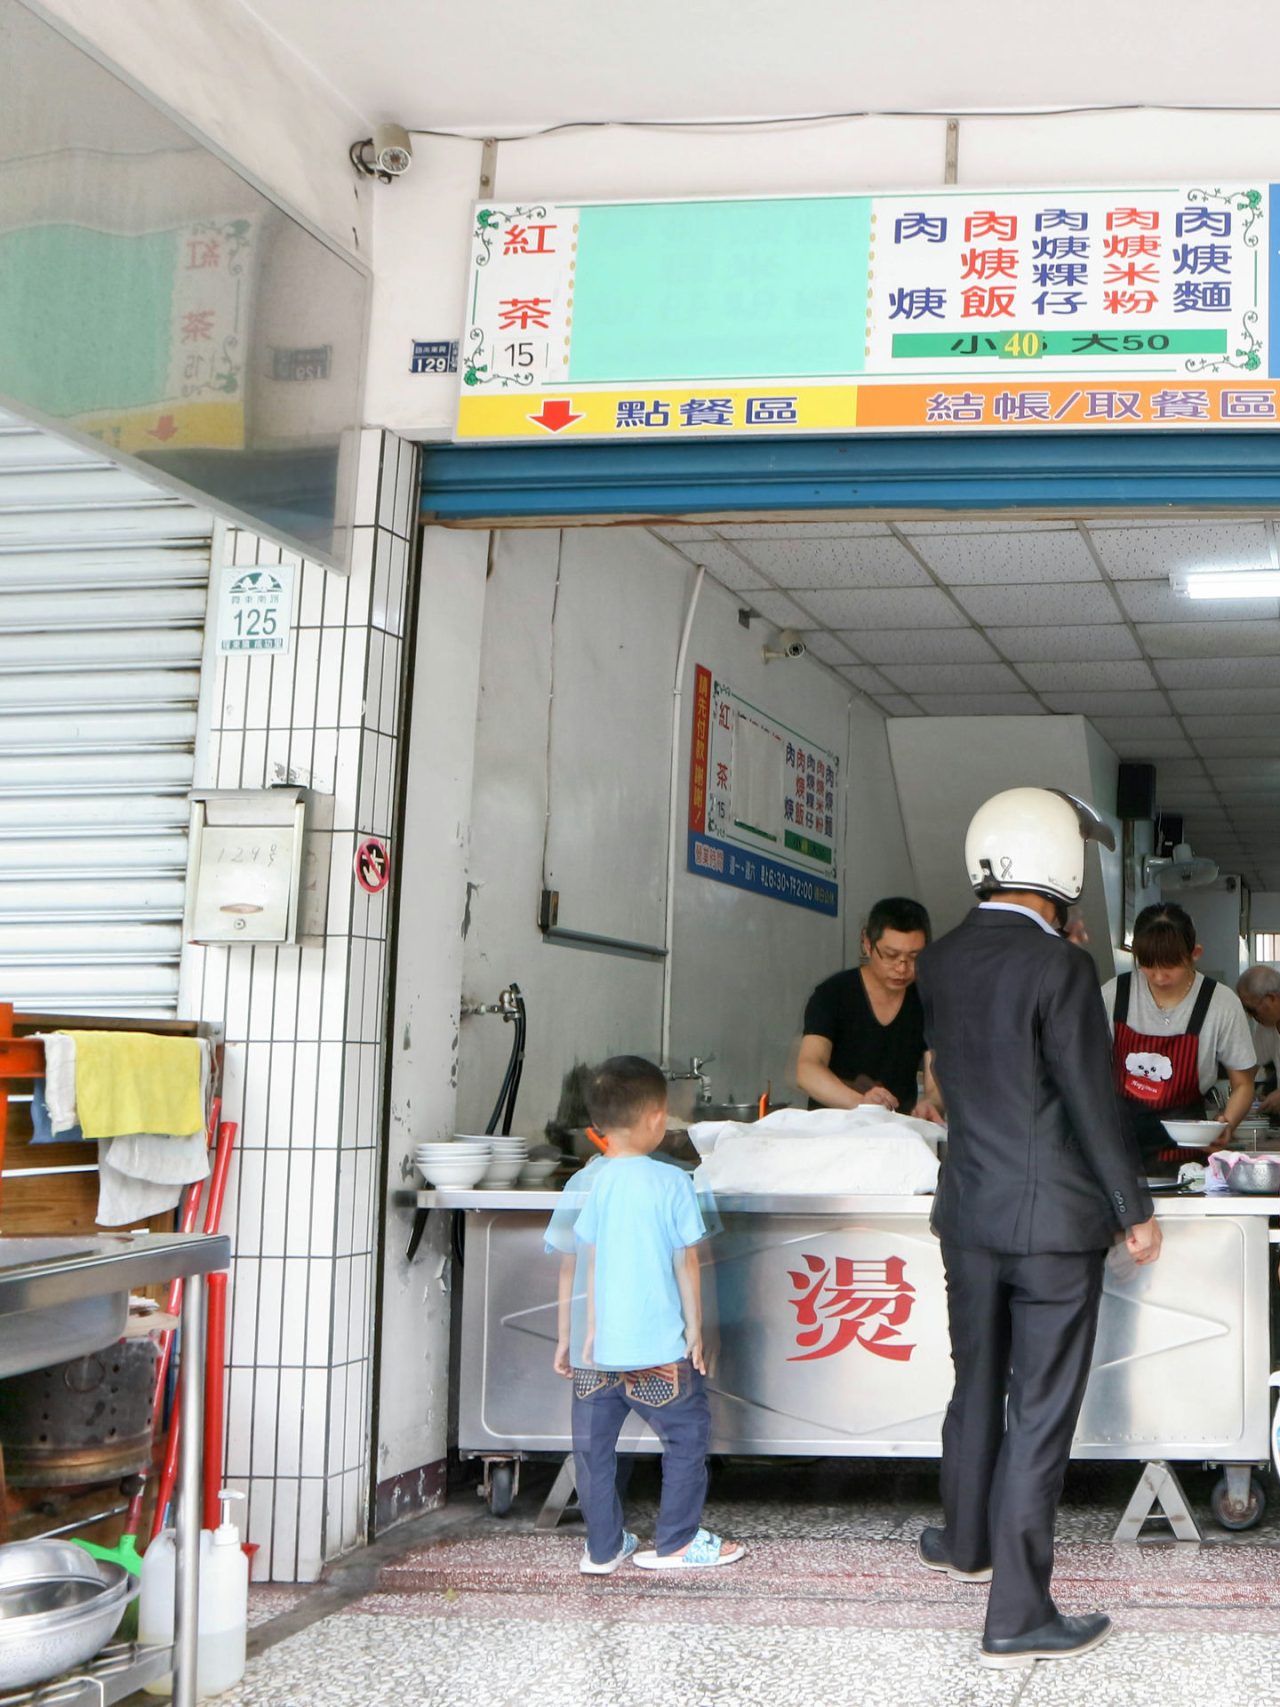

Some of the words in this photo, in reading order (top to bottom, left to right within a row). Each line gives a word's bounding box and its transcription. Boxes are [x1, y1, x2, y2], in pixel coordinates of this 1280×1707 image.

[960, 209, 1020, 318] 肉焿飯
[1102, 207, 1162, 315] 肉焿米粉
[1173, 205, 1233, 313] 肉焿麵
[498, 224, 558, 330] 紅茶
[504, 342, 534, 368] 15
[1071, 333, 1170, 353] 大50
[418, 358, 446, 372] 129
[615, 396, 799, 429] 點餐區
[926, 389, 1277, 422] 結帳/取餐區
[233, 609, 277, 636] 125
[716, 701, 731, 792] 紅茶
[717, 800, 727, 820] 15
[785, 1254, 917, 1361] 燙
